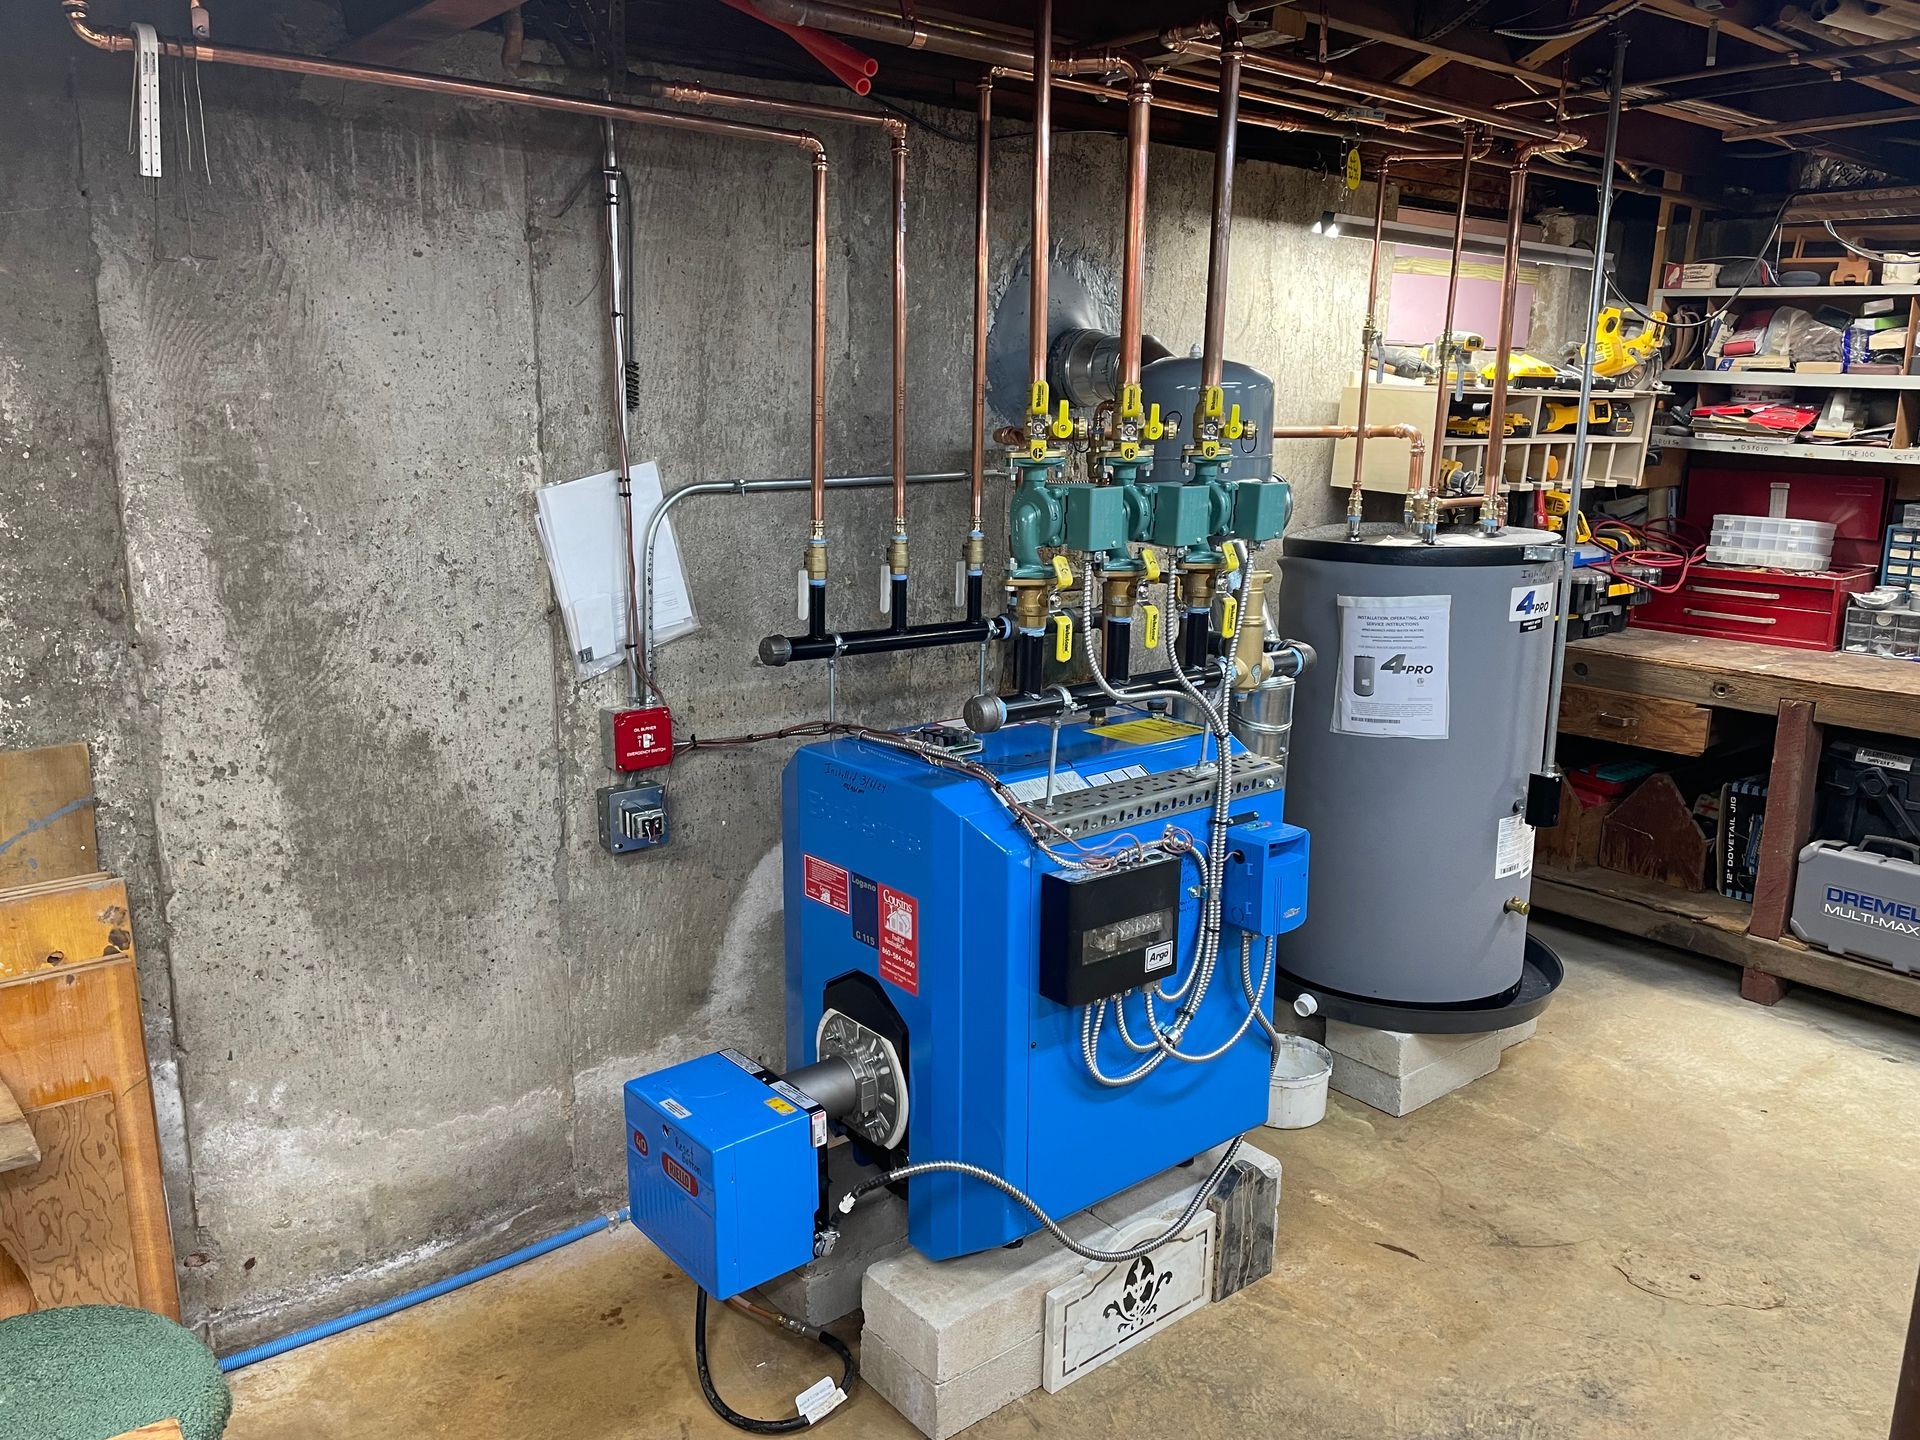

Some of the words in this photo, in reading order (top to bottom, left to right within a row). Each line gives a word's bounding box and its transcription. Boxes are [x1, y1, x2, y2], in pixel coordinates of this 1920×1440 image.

[626, 749, 651, 757] EMERGENCY
[1727, 817, 1736, 867] DOVETAIL
[851, 874, 877, 892] Logano
[883, 889, 912, 913] Cousins
[1826, 887, 1920, 924] DREMEL
[1824, 903, 1920, 937] MULTI-MAX
[863, 934, 875, 946] 115
[1149, 950, 1169, 962] Argo
[636, 1135, 647, 1152] 40
[668, 1160, 691, 1189] RIELLO
